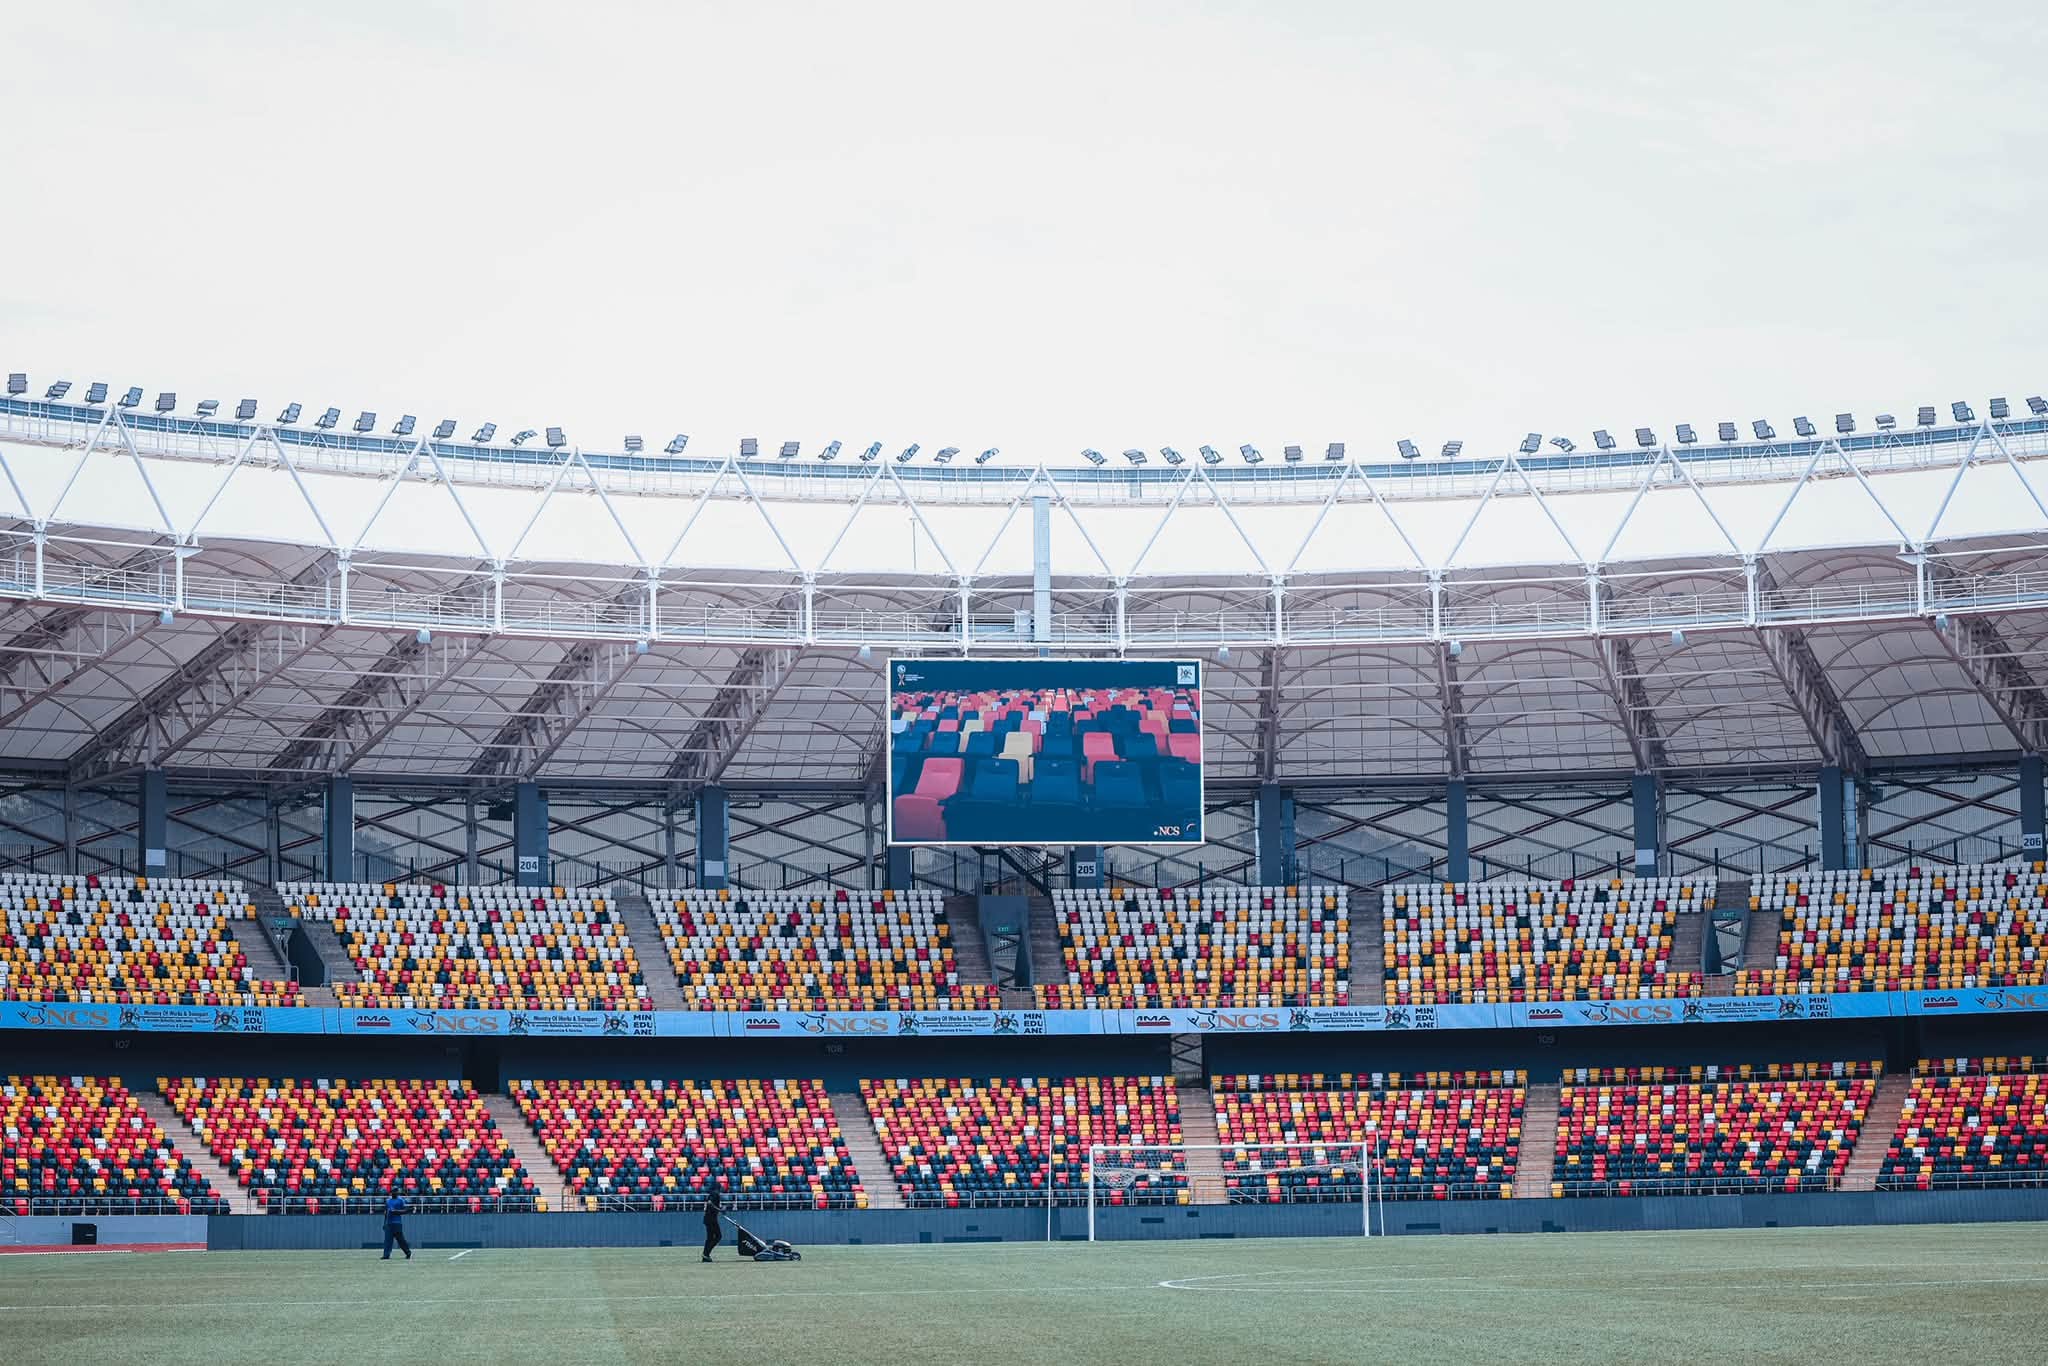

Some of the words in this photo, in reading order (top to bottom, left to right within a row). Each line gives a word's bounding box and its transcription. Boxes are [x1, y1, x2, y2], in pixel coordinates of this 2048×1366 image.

[1159, 826, 1180, 836] NCS
[2023, 837, 2041, 846] 206
[520, 861, 537, 870] 204
[1077, 865, 1095, 874] 205
[47, 1010, 109, 1025] NCS
[1610, 1006, 1672, 1020] NCS
[436, 1016, 499, 1031] NCS
[826, 1018, 888, 1032] NCS
[1217, 1014, 1280, 1028] NCS
